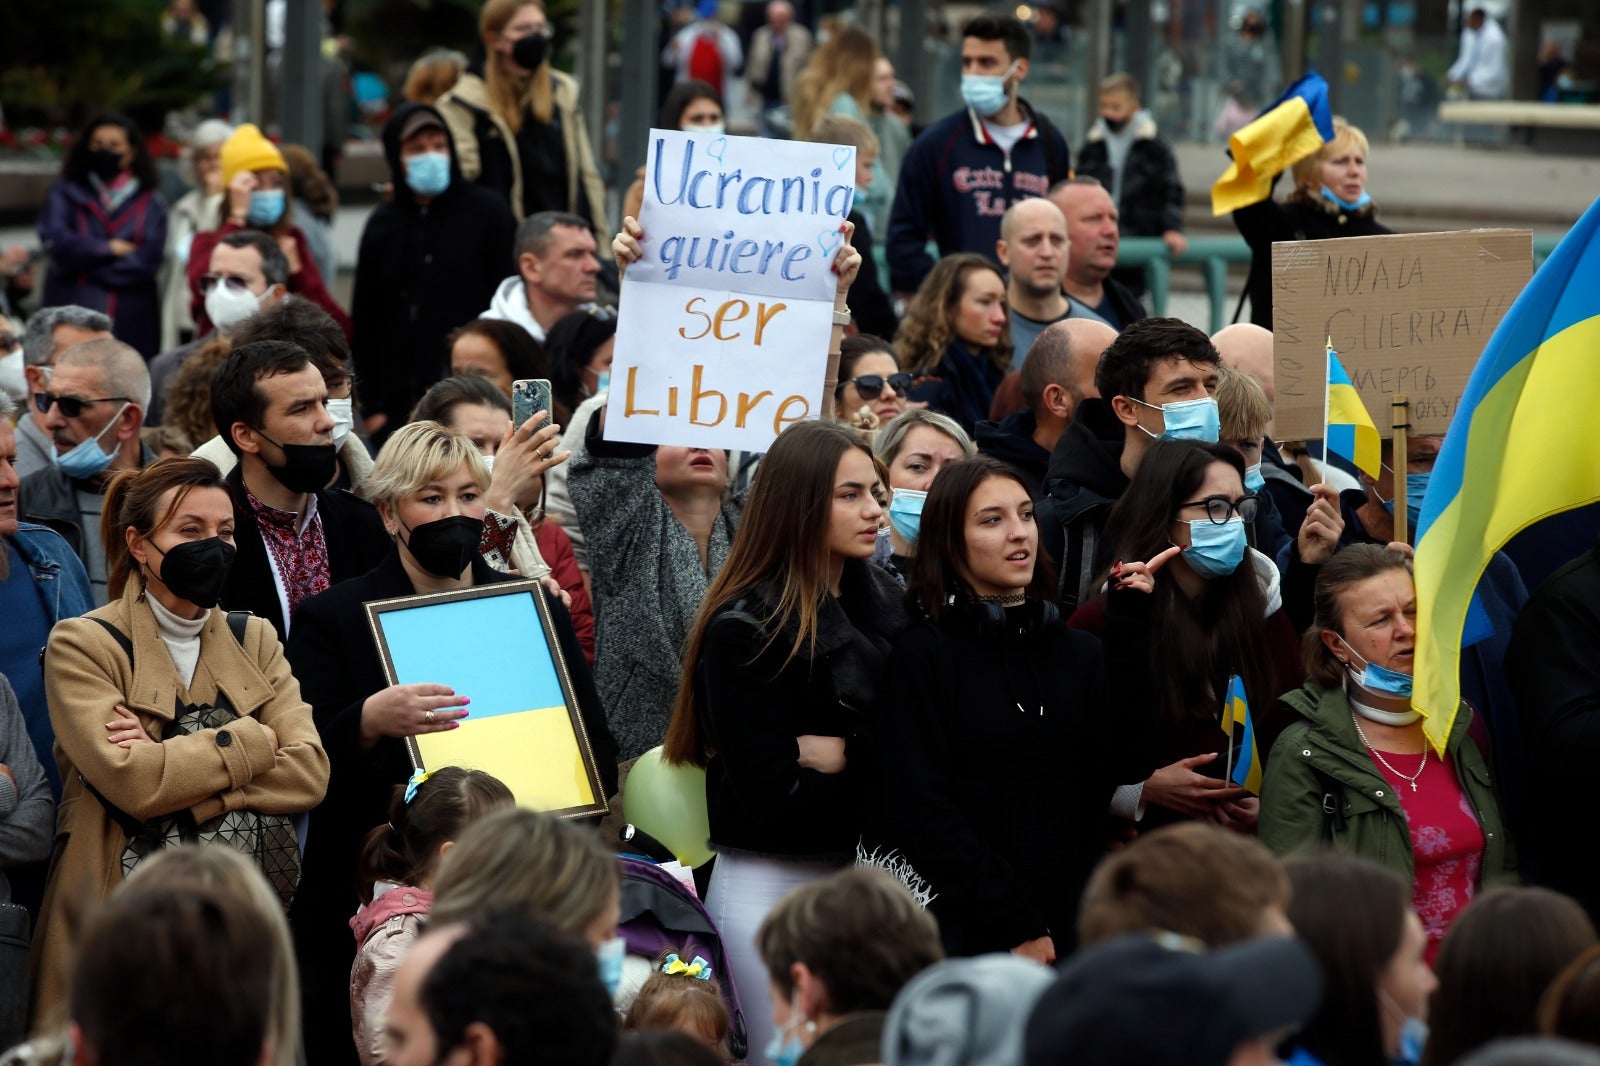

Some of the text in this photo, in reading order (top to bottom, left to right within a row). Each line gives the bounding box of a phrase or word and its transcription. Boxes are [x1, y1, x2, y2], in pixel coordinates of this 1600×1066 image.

[654, 138, 854, 218] Ucrania
[659, 230, 812, 280] quiere
[1372, 257, 1389, 291] A
[1398, 256, 1424, 290] LA
[679, 297, 787, 346] ser
[624, 364, 810, 438] Libre
[1279, 357, 1304, 396] NO
[1350, 365, 1437, 395] МЕРТЬ
